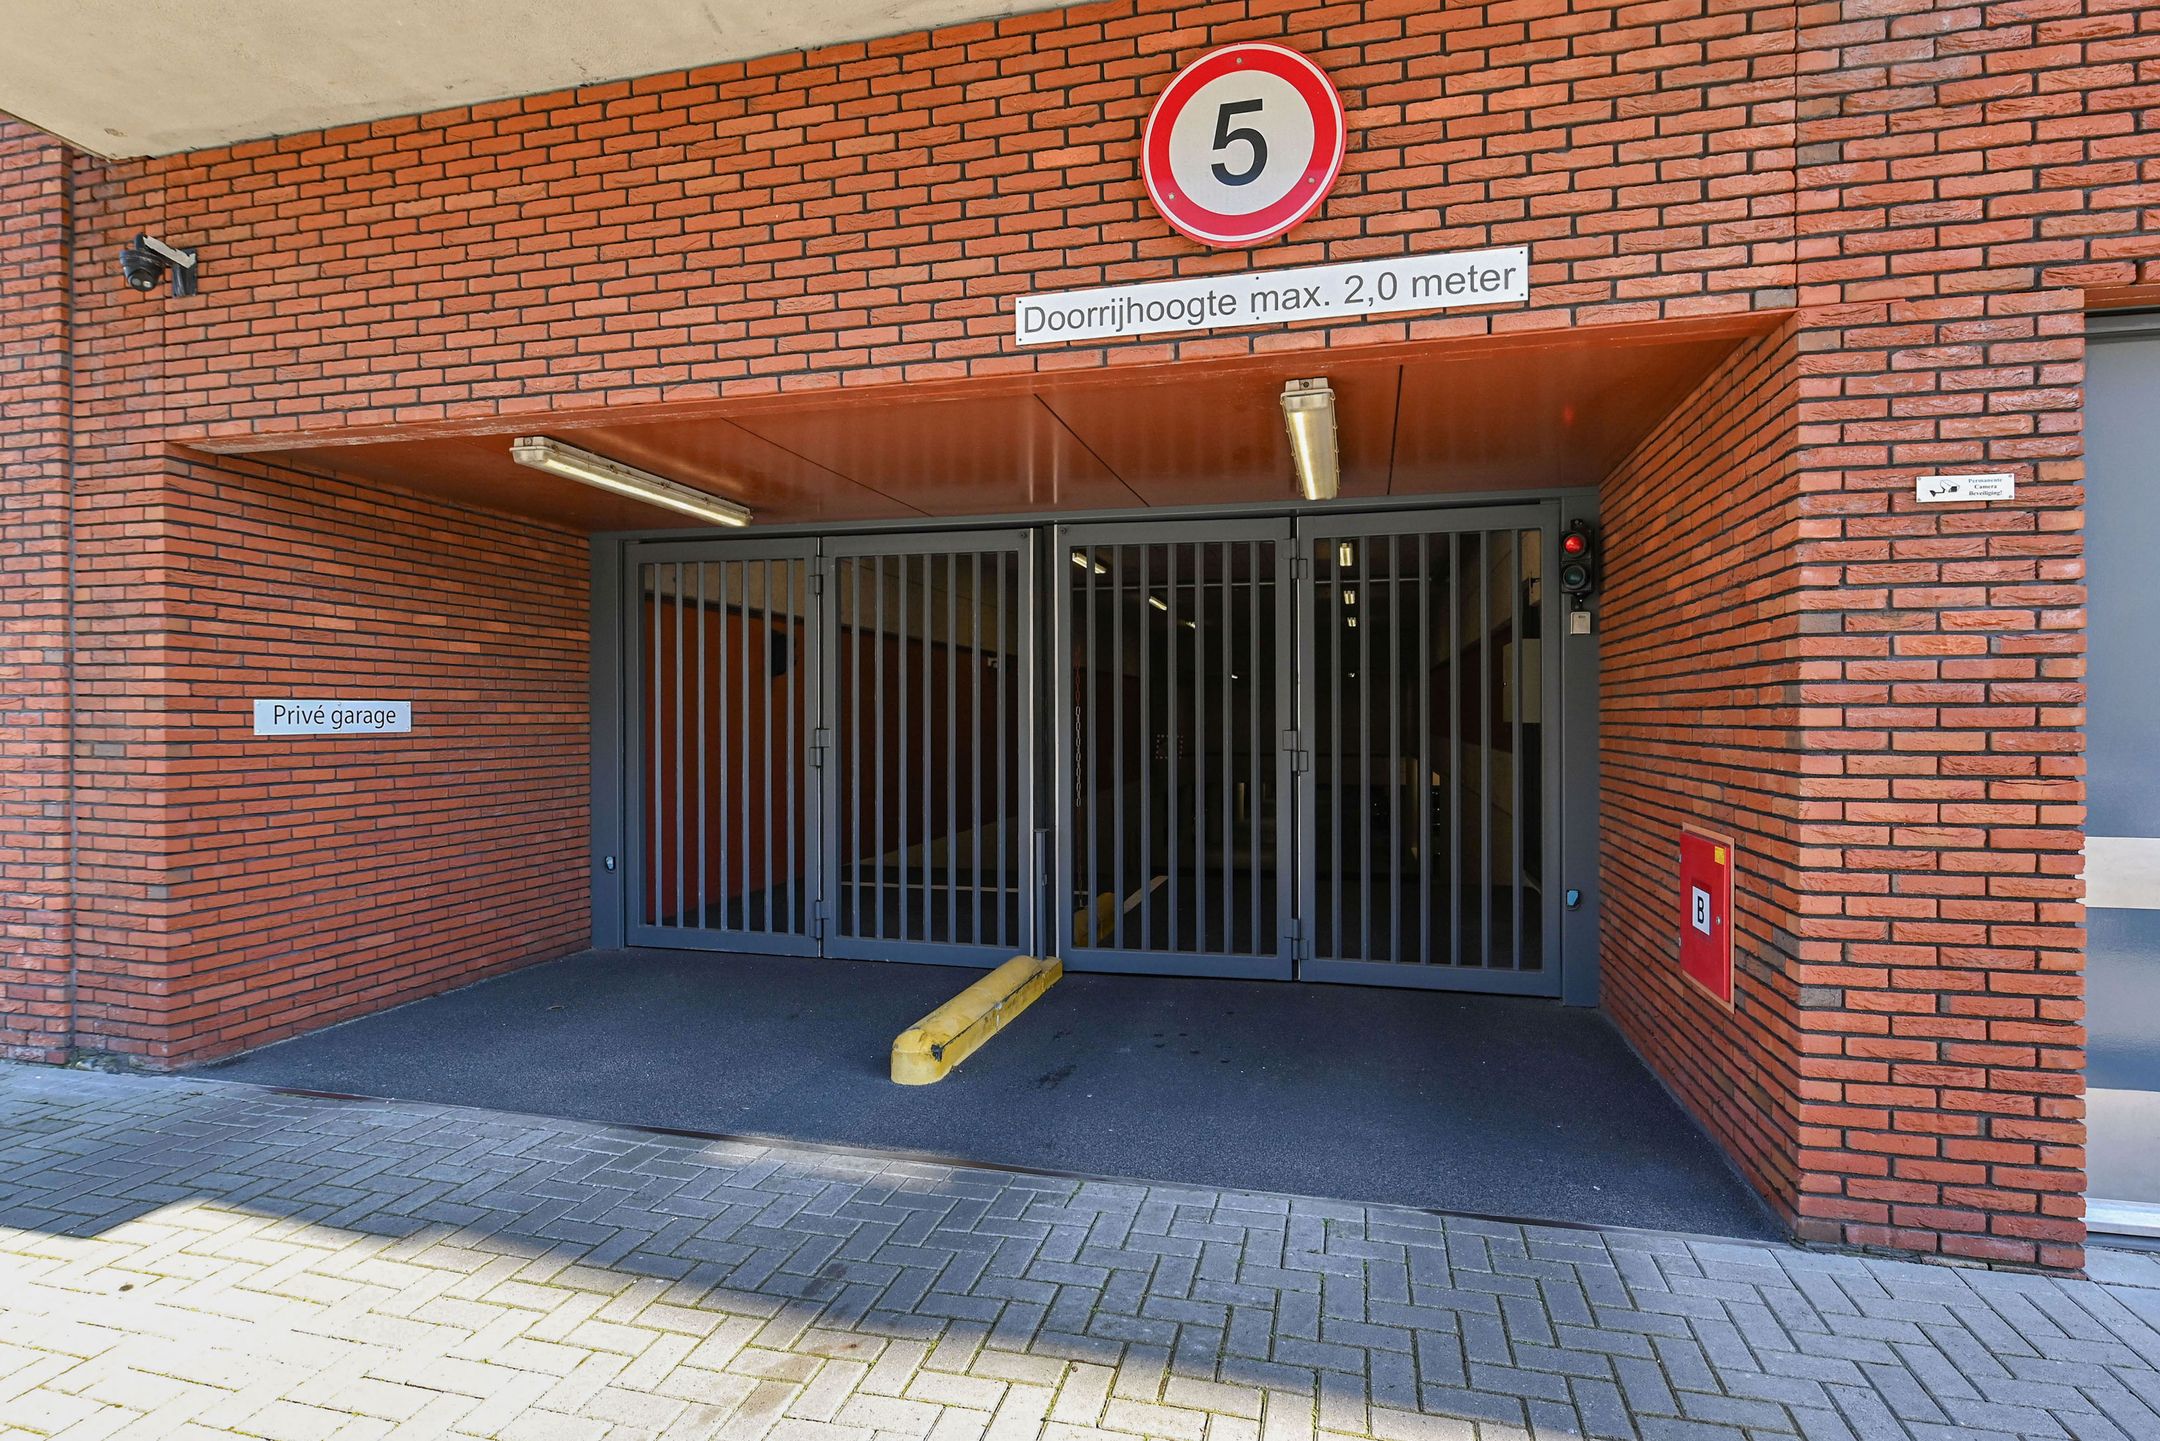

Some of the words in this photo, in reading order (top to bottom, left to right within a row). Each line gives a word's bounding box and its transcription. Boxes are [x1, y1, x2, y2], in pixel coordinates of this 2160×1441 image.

[1211, 98, 1268, 187] 5
[1023, 288, 1237, 334] Doorrijhoogte
[1250, 281, 1330, 314] max.
[1344, 270, 1398, 307] 2,0
[1412, 263, 1517, 297] meter
[274, 704, 325, 725] Privé
[331, 709, 396, 730] garage
[1697, 895, 1704, 924] B
